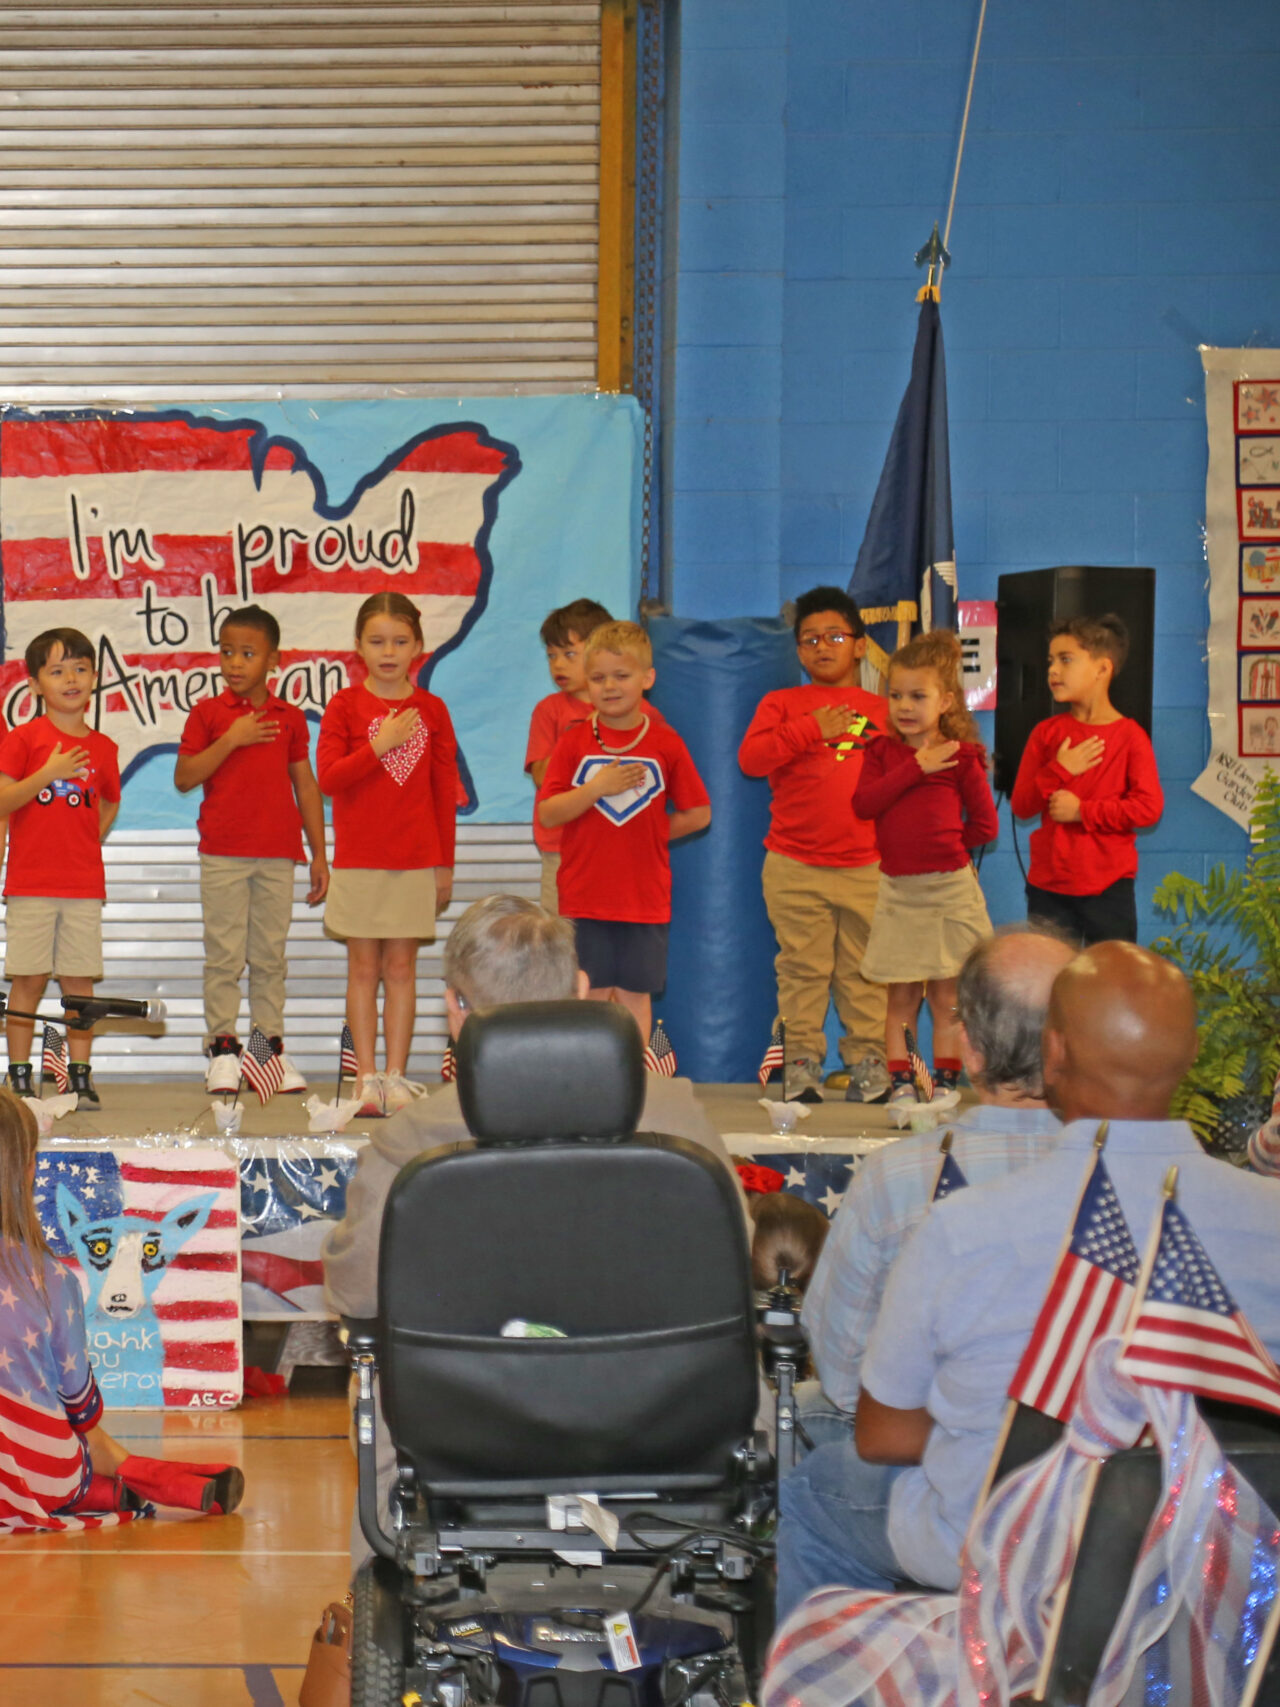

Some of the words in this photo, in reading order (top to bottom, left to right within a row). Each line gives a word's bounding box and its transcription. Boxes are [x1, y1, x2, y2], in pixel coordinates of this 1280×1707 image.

[70, 492, 158, 576] I'm
[237, 487, 416, 602] proud
[135, 585, 190, 647] to
[87, 1352, 120, 1369] ou
